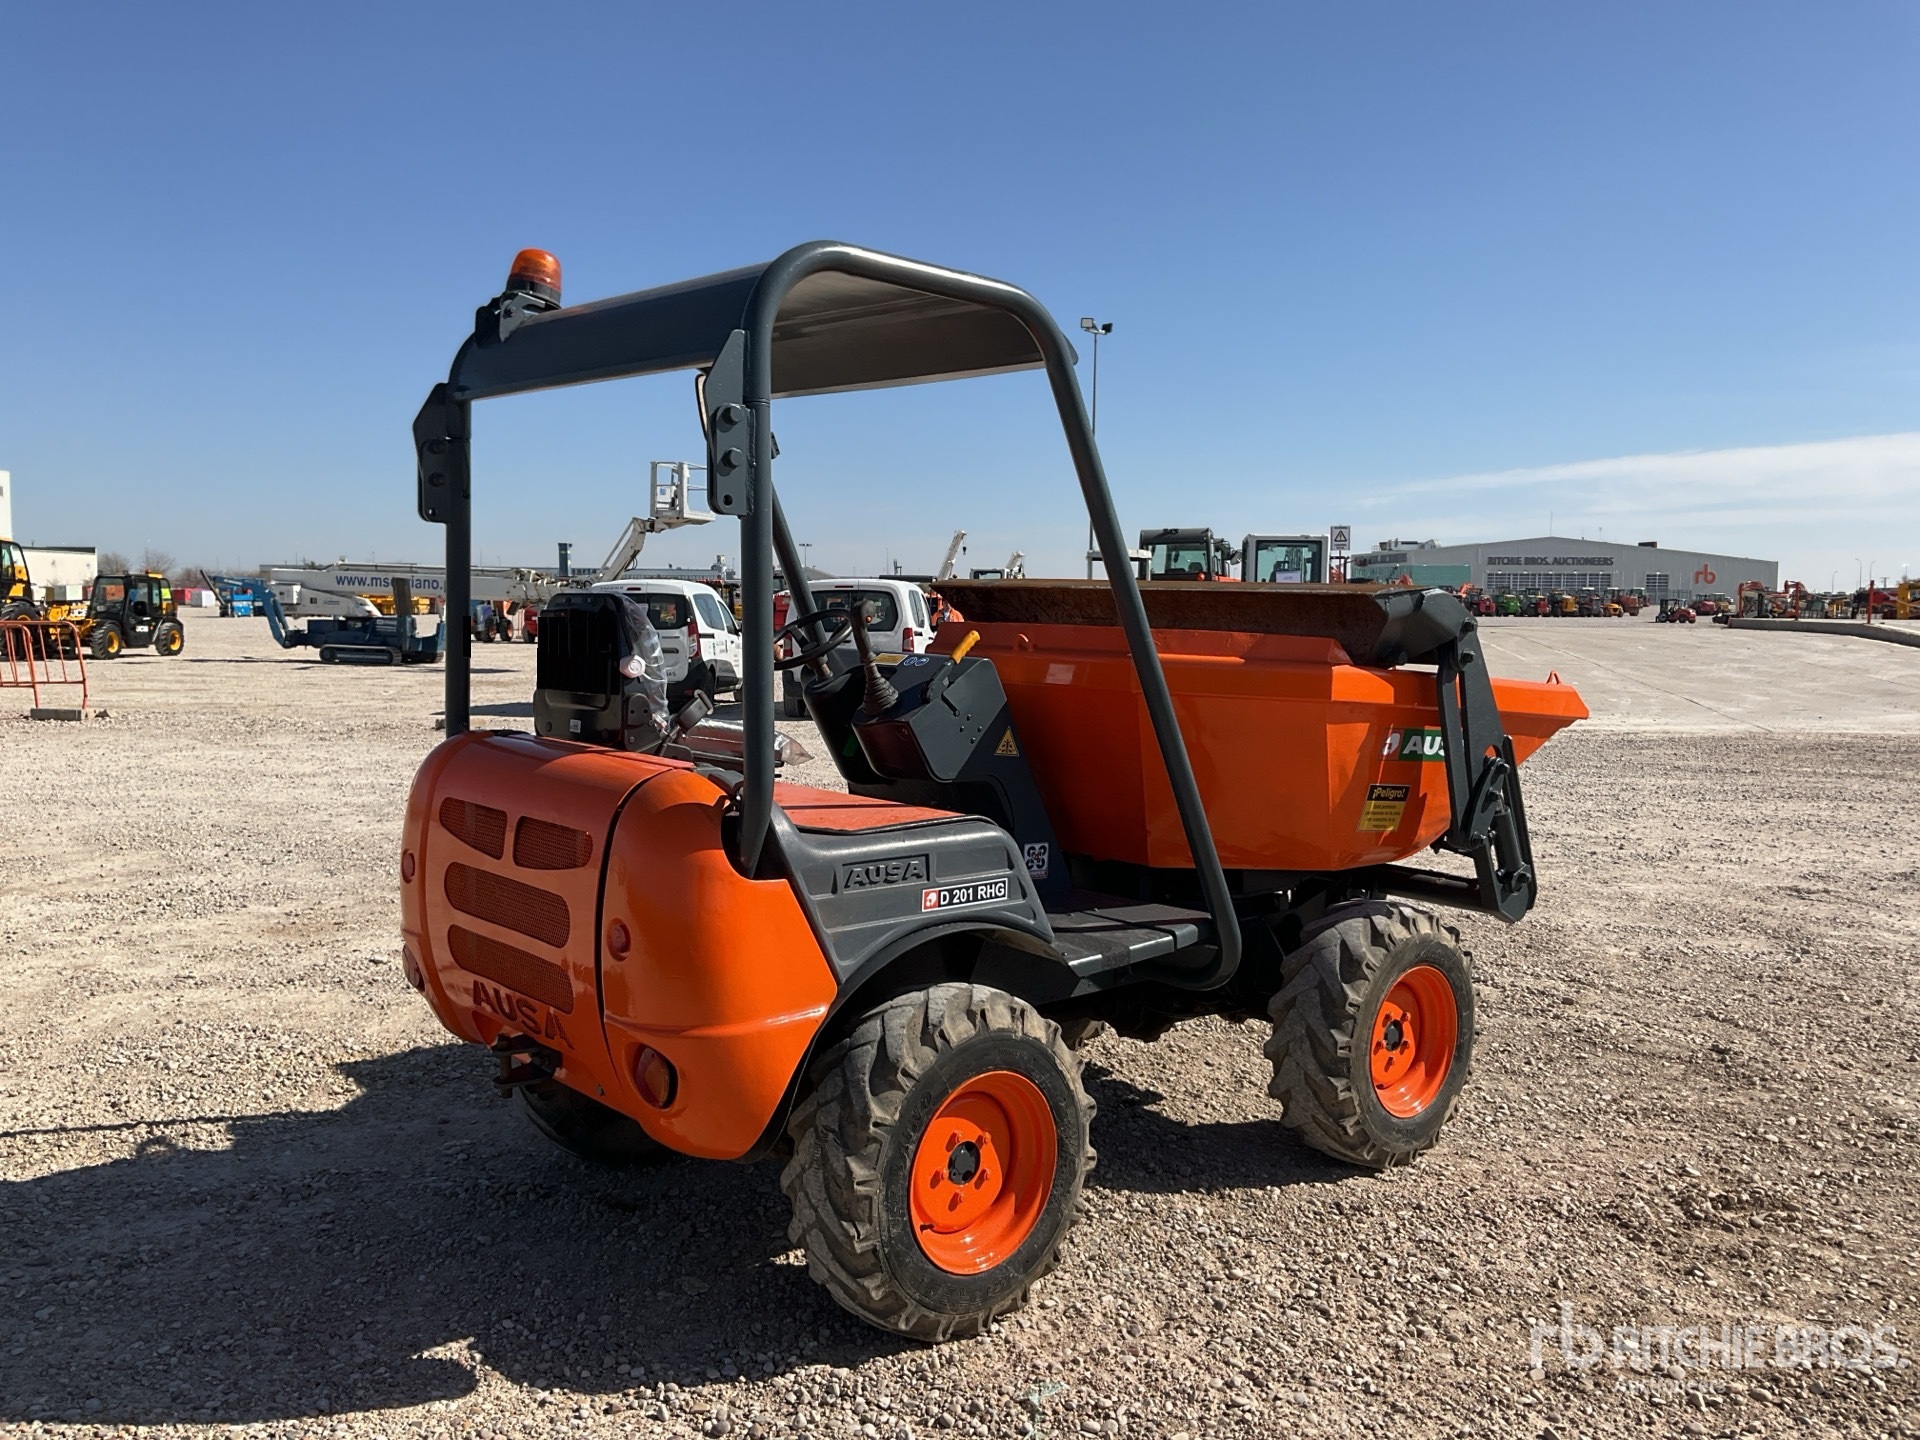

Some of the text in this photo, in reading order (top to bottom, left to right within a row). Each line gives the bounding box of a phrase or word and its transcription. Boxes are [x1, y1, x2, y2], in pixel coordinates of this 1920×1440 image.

[1487, 556, 1614, 566] RITCHIE BROS. AUCTIONEERS
[1694, 563, 1717, 585] rb
[844, 859, 926, 889] AUSA
[940, 881, 1005, 906] D 201 RHG
[472, 979, 575, 1050] AUSA
